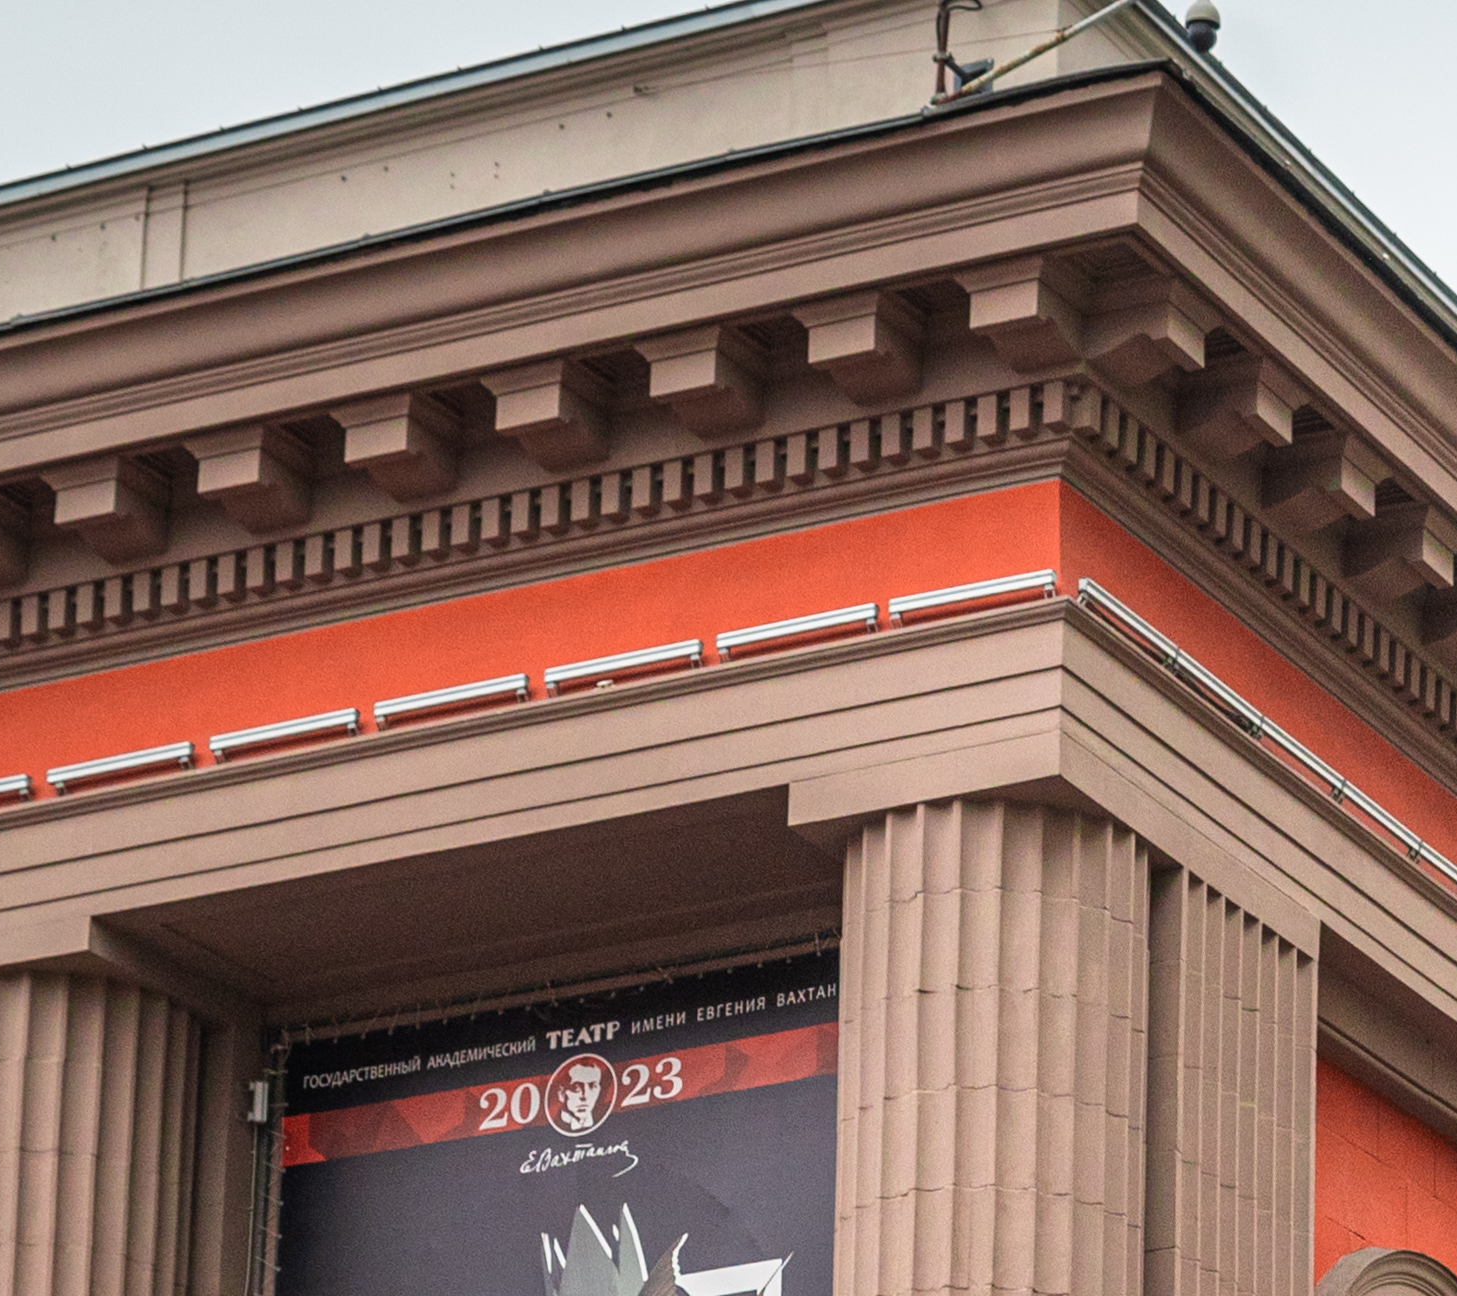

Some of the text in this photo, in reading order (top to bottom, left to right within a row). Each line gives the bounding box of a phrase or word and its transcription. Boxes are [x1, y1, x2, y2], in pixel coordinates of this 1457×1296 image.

[303, 1055, 420, 1088] ГОСУДАРСТВЕННЫЙ
[427, 1036, 535, 1068] АКАДЕМИЧЕСКИЙ
[546, 1021, 619, 1049] ТЕАТР
[631, 1011, 685, 1034] ИМЕНИ
[696, 996, 765, 1021] ЕВГЕНИЯ
[479, 1057, 682, 1130] 20 23
